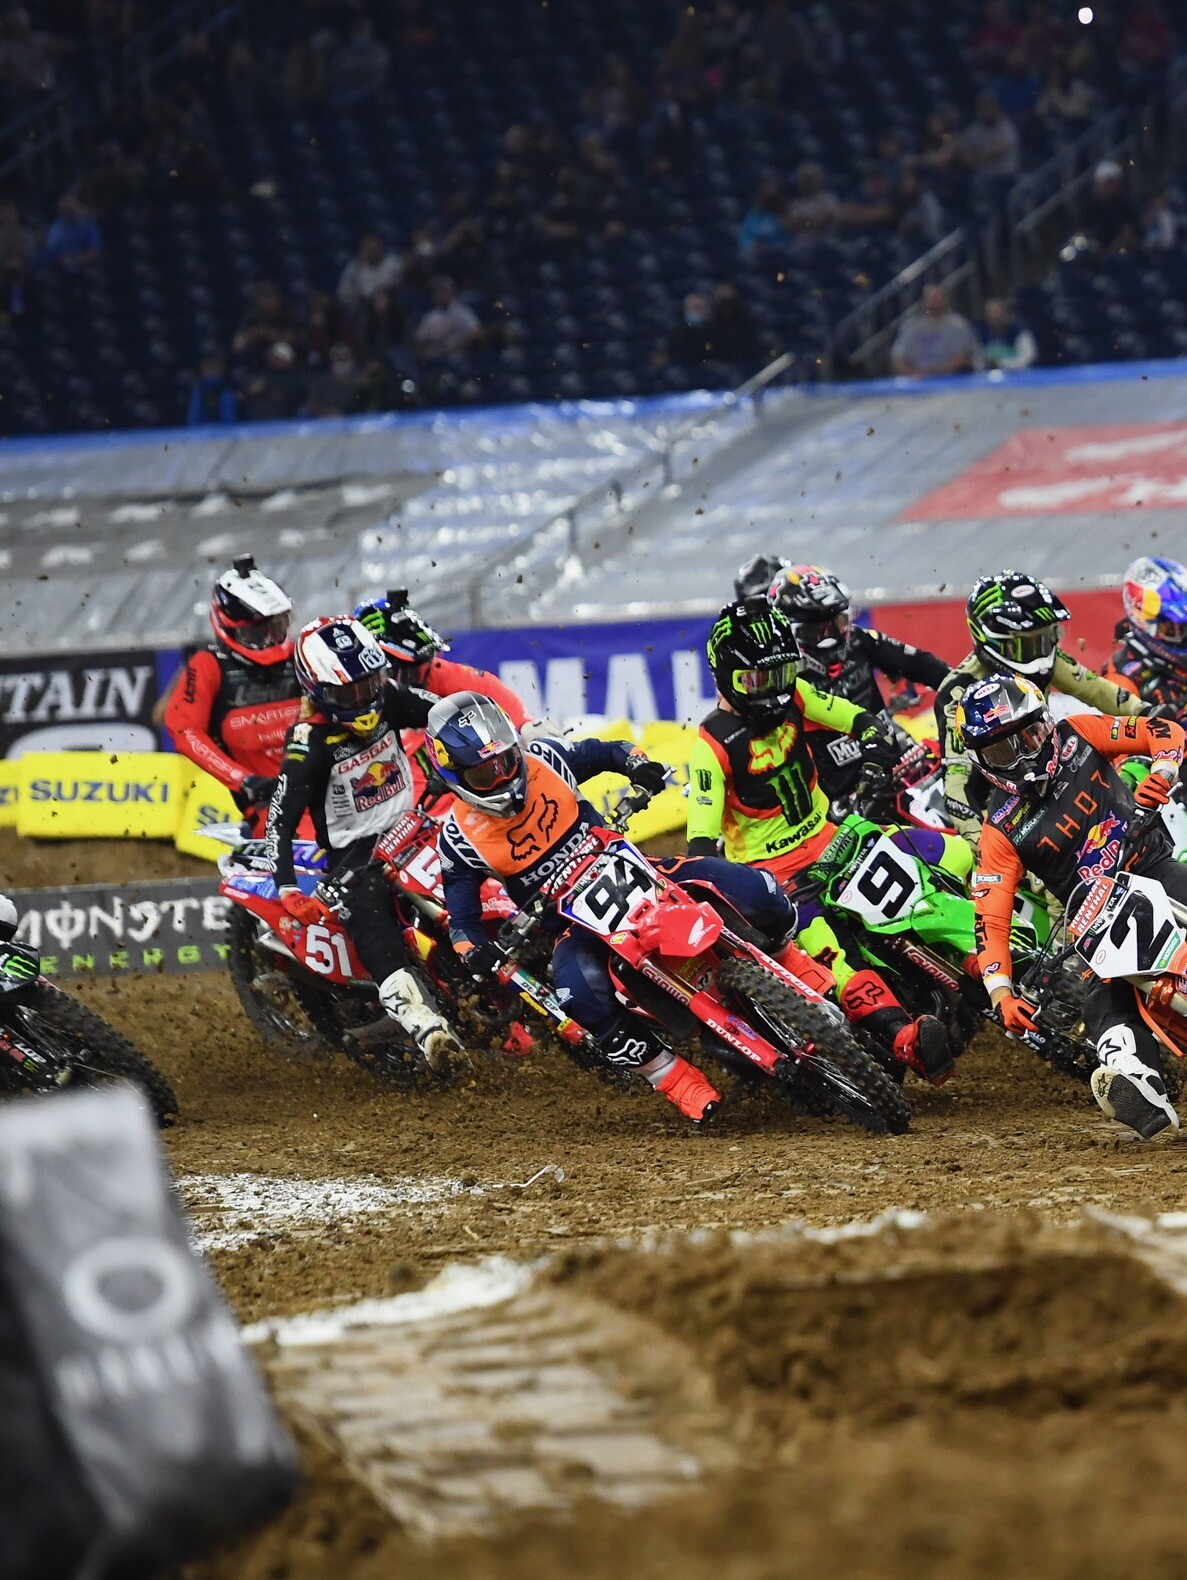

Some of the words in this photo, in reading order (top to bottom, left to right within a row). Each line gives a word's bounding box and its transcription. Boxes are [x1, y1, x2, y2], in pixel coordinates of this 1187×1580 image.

[29, 780, 169, 803] SUZUKI
[357, 789, 385, 810] Red
[384, 775, 405, 798] Bull
[385, 820, 418, 855] RENTHAL
[1020, 809, 1045, 836] MOTOREX
[518, 822, 590, 887] HONDA
[585, 857, 653, 934] 94
[857, 850, 916, 919] 9
[1078, 883, 1110, 932] RENTHAL
[13, 895, 234, 950] MONSTE
[1109, 889, 1175, 972] 2
[305, 923, 352, 978] 51
[642, 966, 691, 1007] SHOWA
[704, 1017, 762, 1064] DUNLOP
